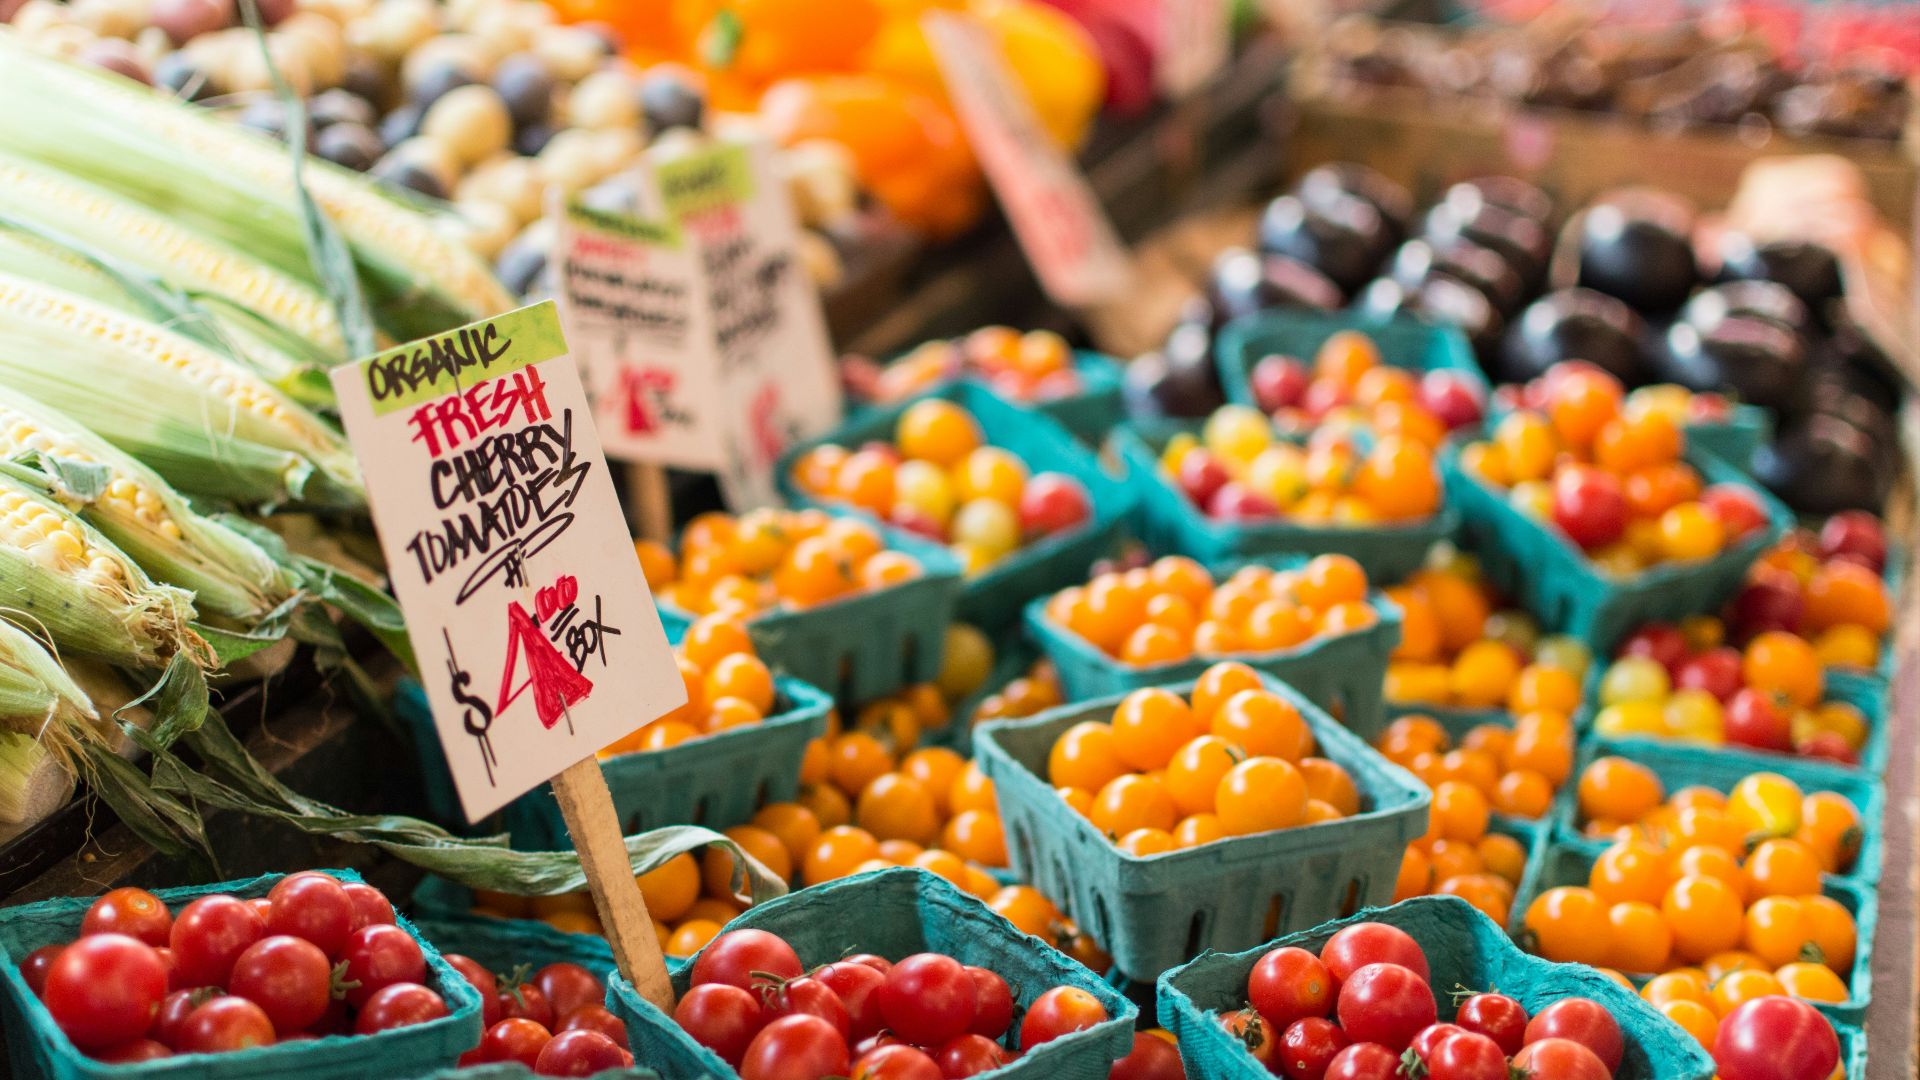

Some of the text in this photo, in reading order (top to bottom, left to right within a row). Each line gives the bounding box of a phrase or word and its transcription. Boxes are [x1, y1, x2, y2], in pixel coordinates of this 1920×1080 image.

[370, 324, 512, 401] ORGANIC
[408, 364, 552, 458] FRESH
[431, 408, 574, 510] CHERRY
[406, 453, 591, 584] TOMATOES
[565, 594, 621, 674] BOX
